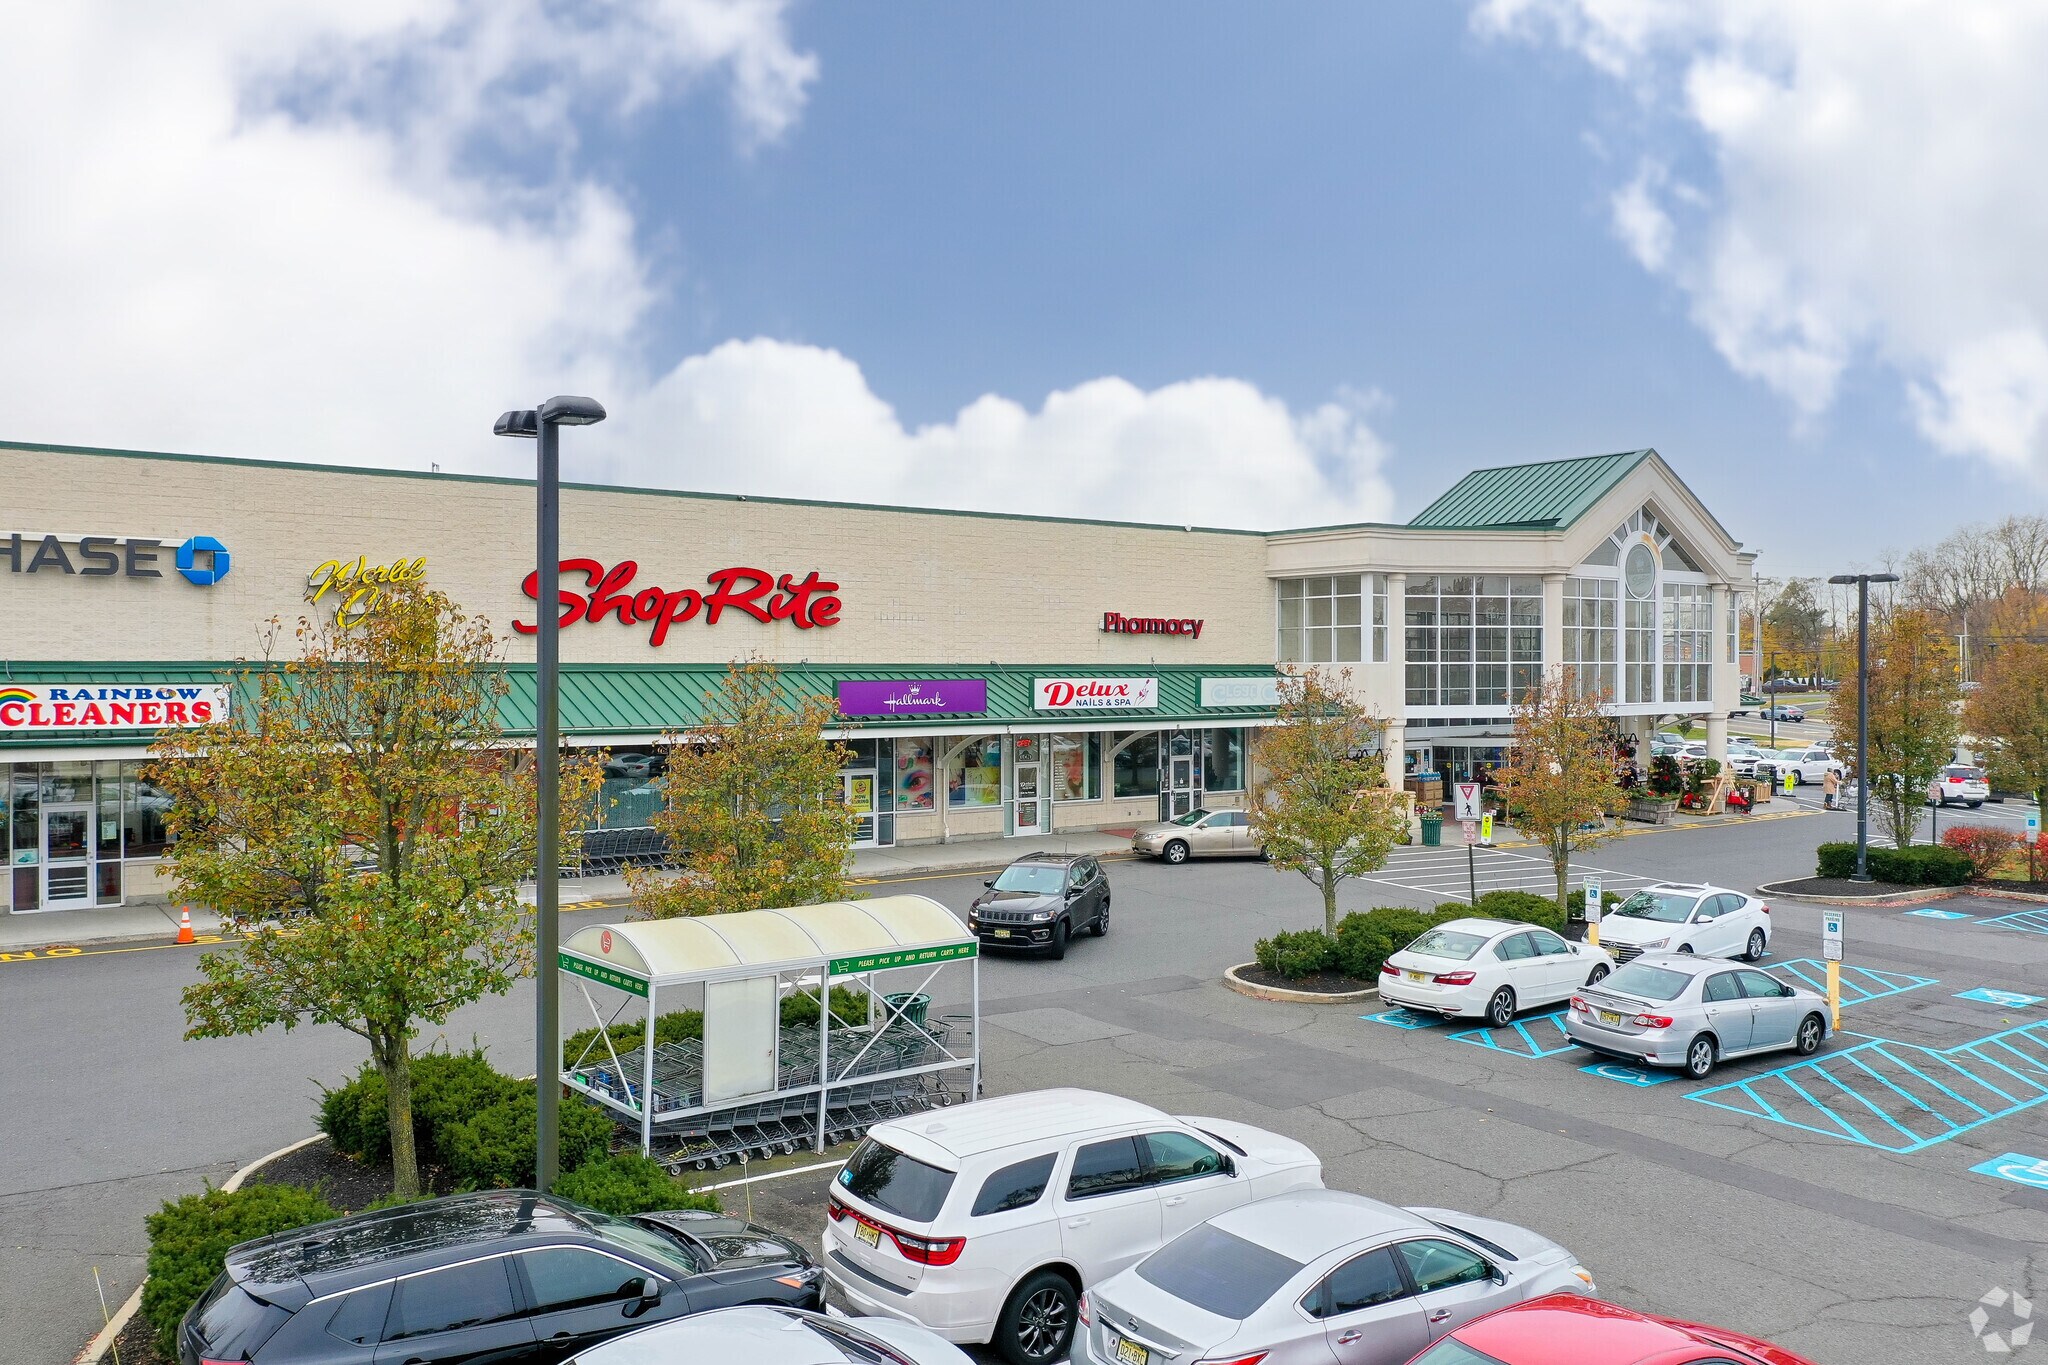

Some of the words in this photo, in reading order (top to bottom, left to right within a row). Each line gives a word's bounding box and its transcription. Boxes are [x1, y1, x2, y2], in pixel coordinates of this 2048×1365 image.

[0, 533, 163, 578] HASE
[512, 558, 842, 647] ShopRite
[1103, 612, 1204, 639] Pharmacy
[50, 688, 202, 700] RAINBOW
[883, 692, 947, 712] Hallmark
[1044, 681, 1130, 707] Delux
[1114, 698, 1131, 706] SPA
[0, 702, 212, 727] CLEANERS
[858, 959, 875, 967] PLEASE
[878, 957, 890, 965] PICK
[894, 955, 902, 963] UP
[919, 951, 937, 960] RETURN
[940, 948, 954, 956] CARTS
[573, 962, 583, 970] PLEASE
[635, 982, 643, 991] HERE
